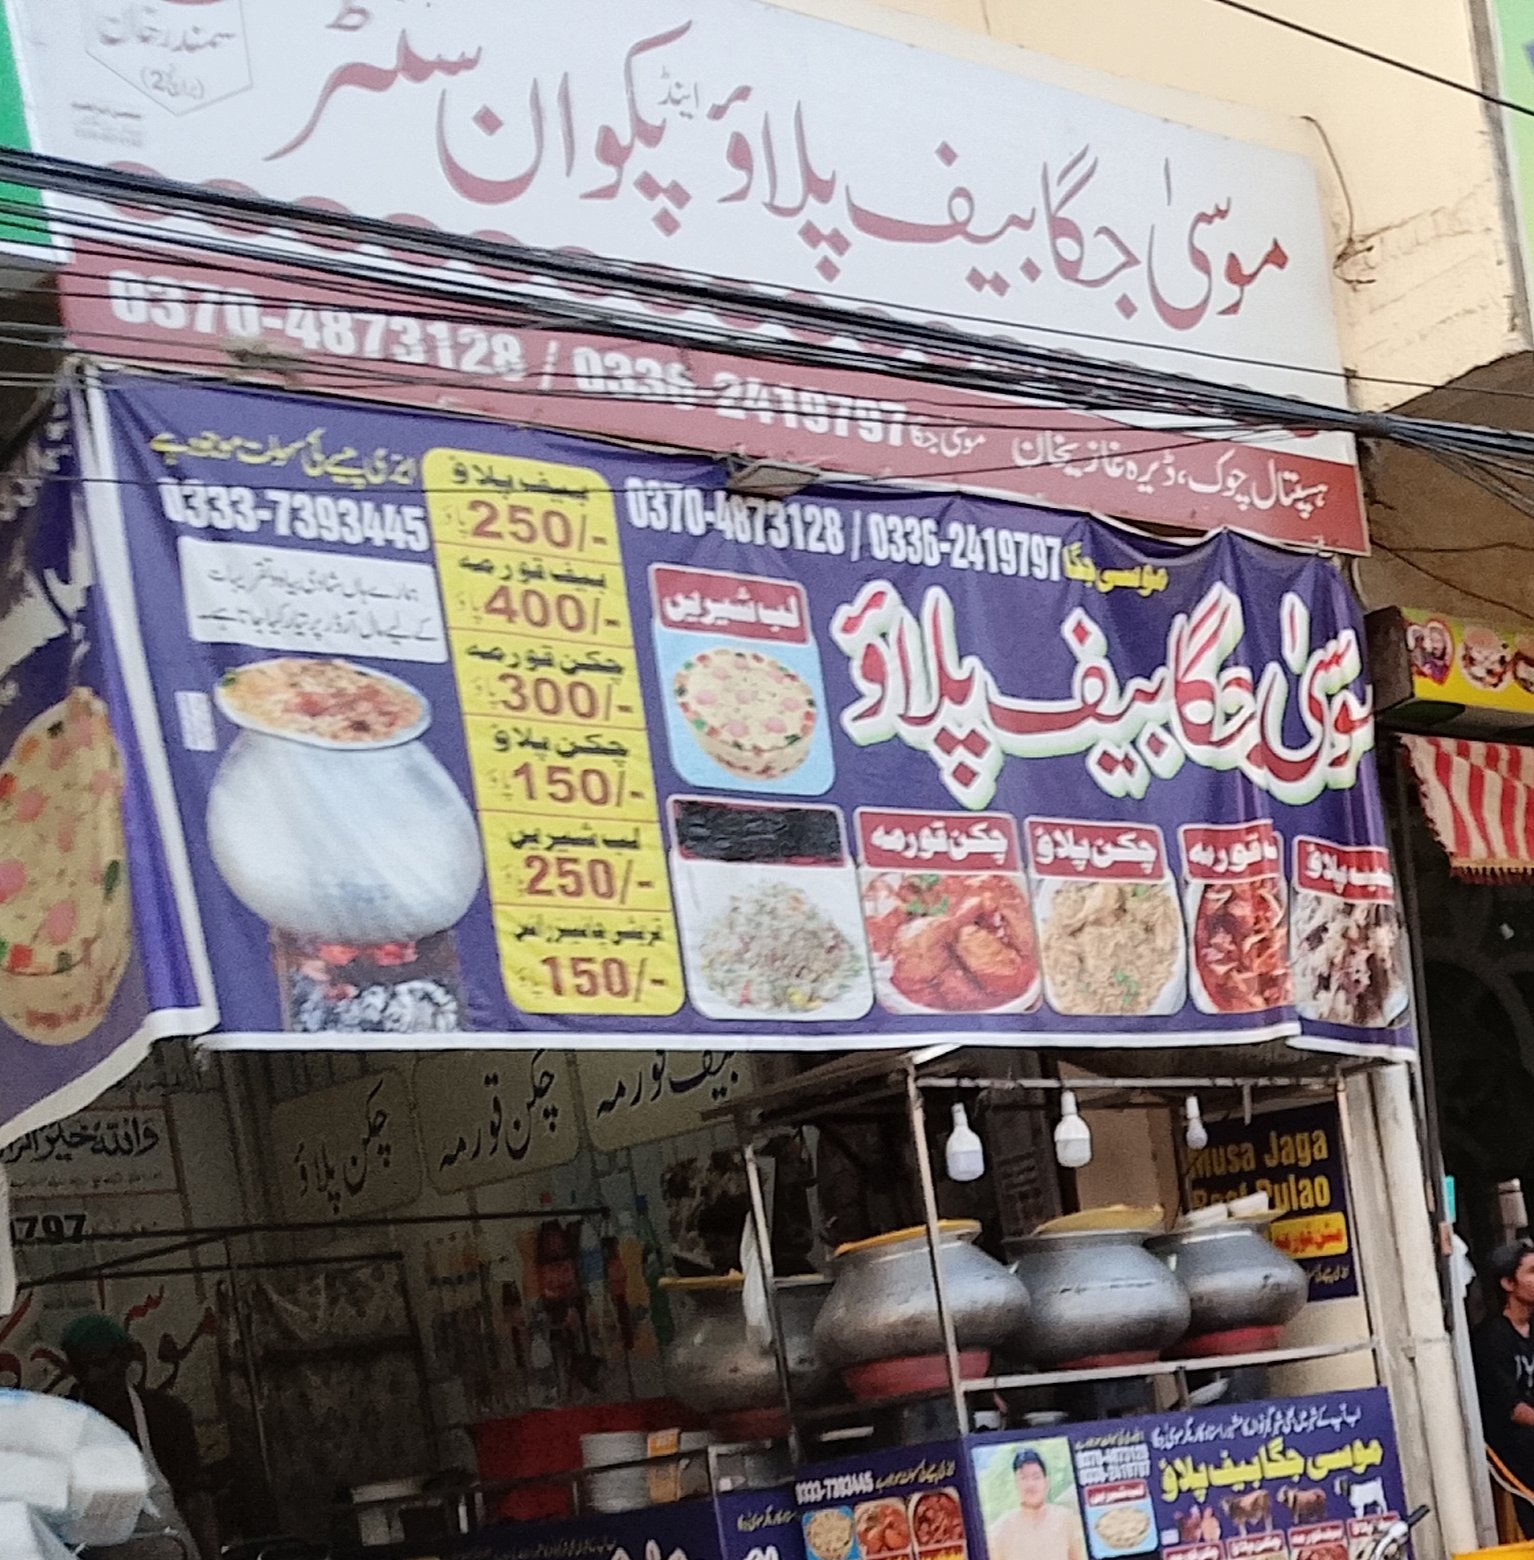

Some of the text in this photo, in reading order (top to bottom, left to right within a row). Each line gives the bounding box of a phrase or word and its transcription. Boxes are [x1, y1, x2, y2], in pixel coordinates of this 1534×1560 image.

[435, 19, 695, 238] پکوان
[844, 140, 1042, 299] بیف
[108, 270, 524, 382] 0370-4873128
[1125, 450, 1177, 495] ڈیرہ
[1252, 458, 1329, 520] ہسپتال
[157, 475, 433, 553] 0333-7393445
[467, 499, 609, 554] 250/-
[624, 476, 846, 557] 0370-4873128
[867, 512, 1063, 582] 0336-2419797
[483, 584, 621, 637] 400/-
[497, 672, 634, 722] 300/-
[985, 605, 1170, 799] بیف
[513, 761, 646, 808] 150/-
[869, 819, 1010, 866] چکن قورمہ
[1034, 827, 1159, 874] چکن پلاؤ
[523, 854, 655, 906] 250/-
[540, 954, 667, 1003] 150/-
[1263, 1128, 1330, 1169] Jaga
